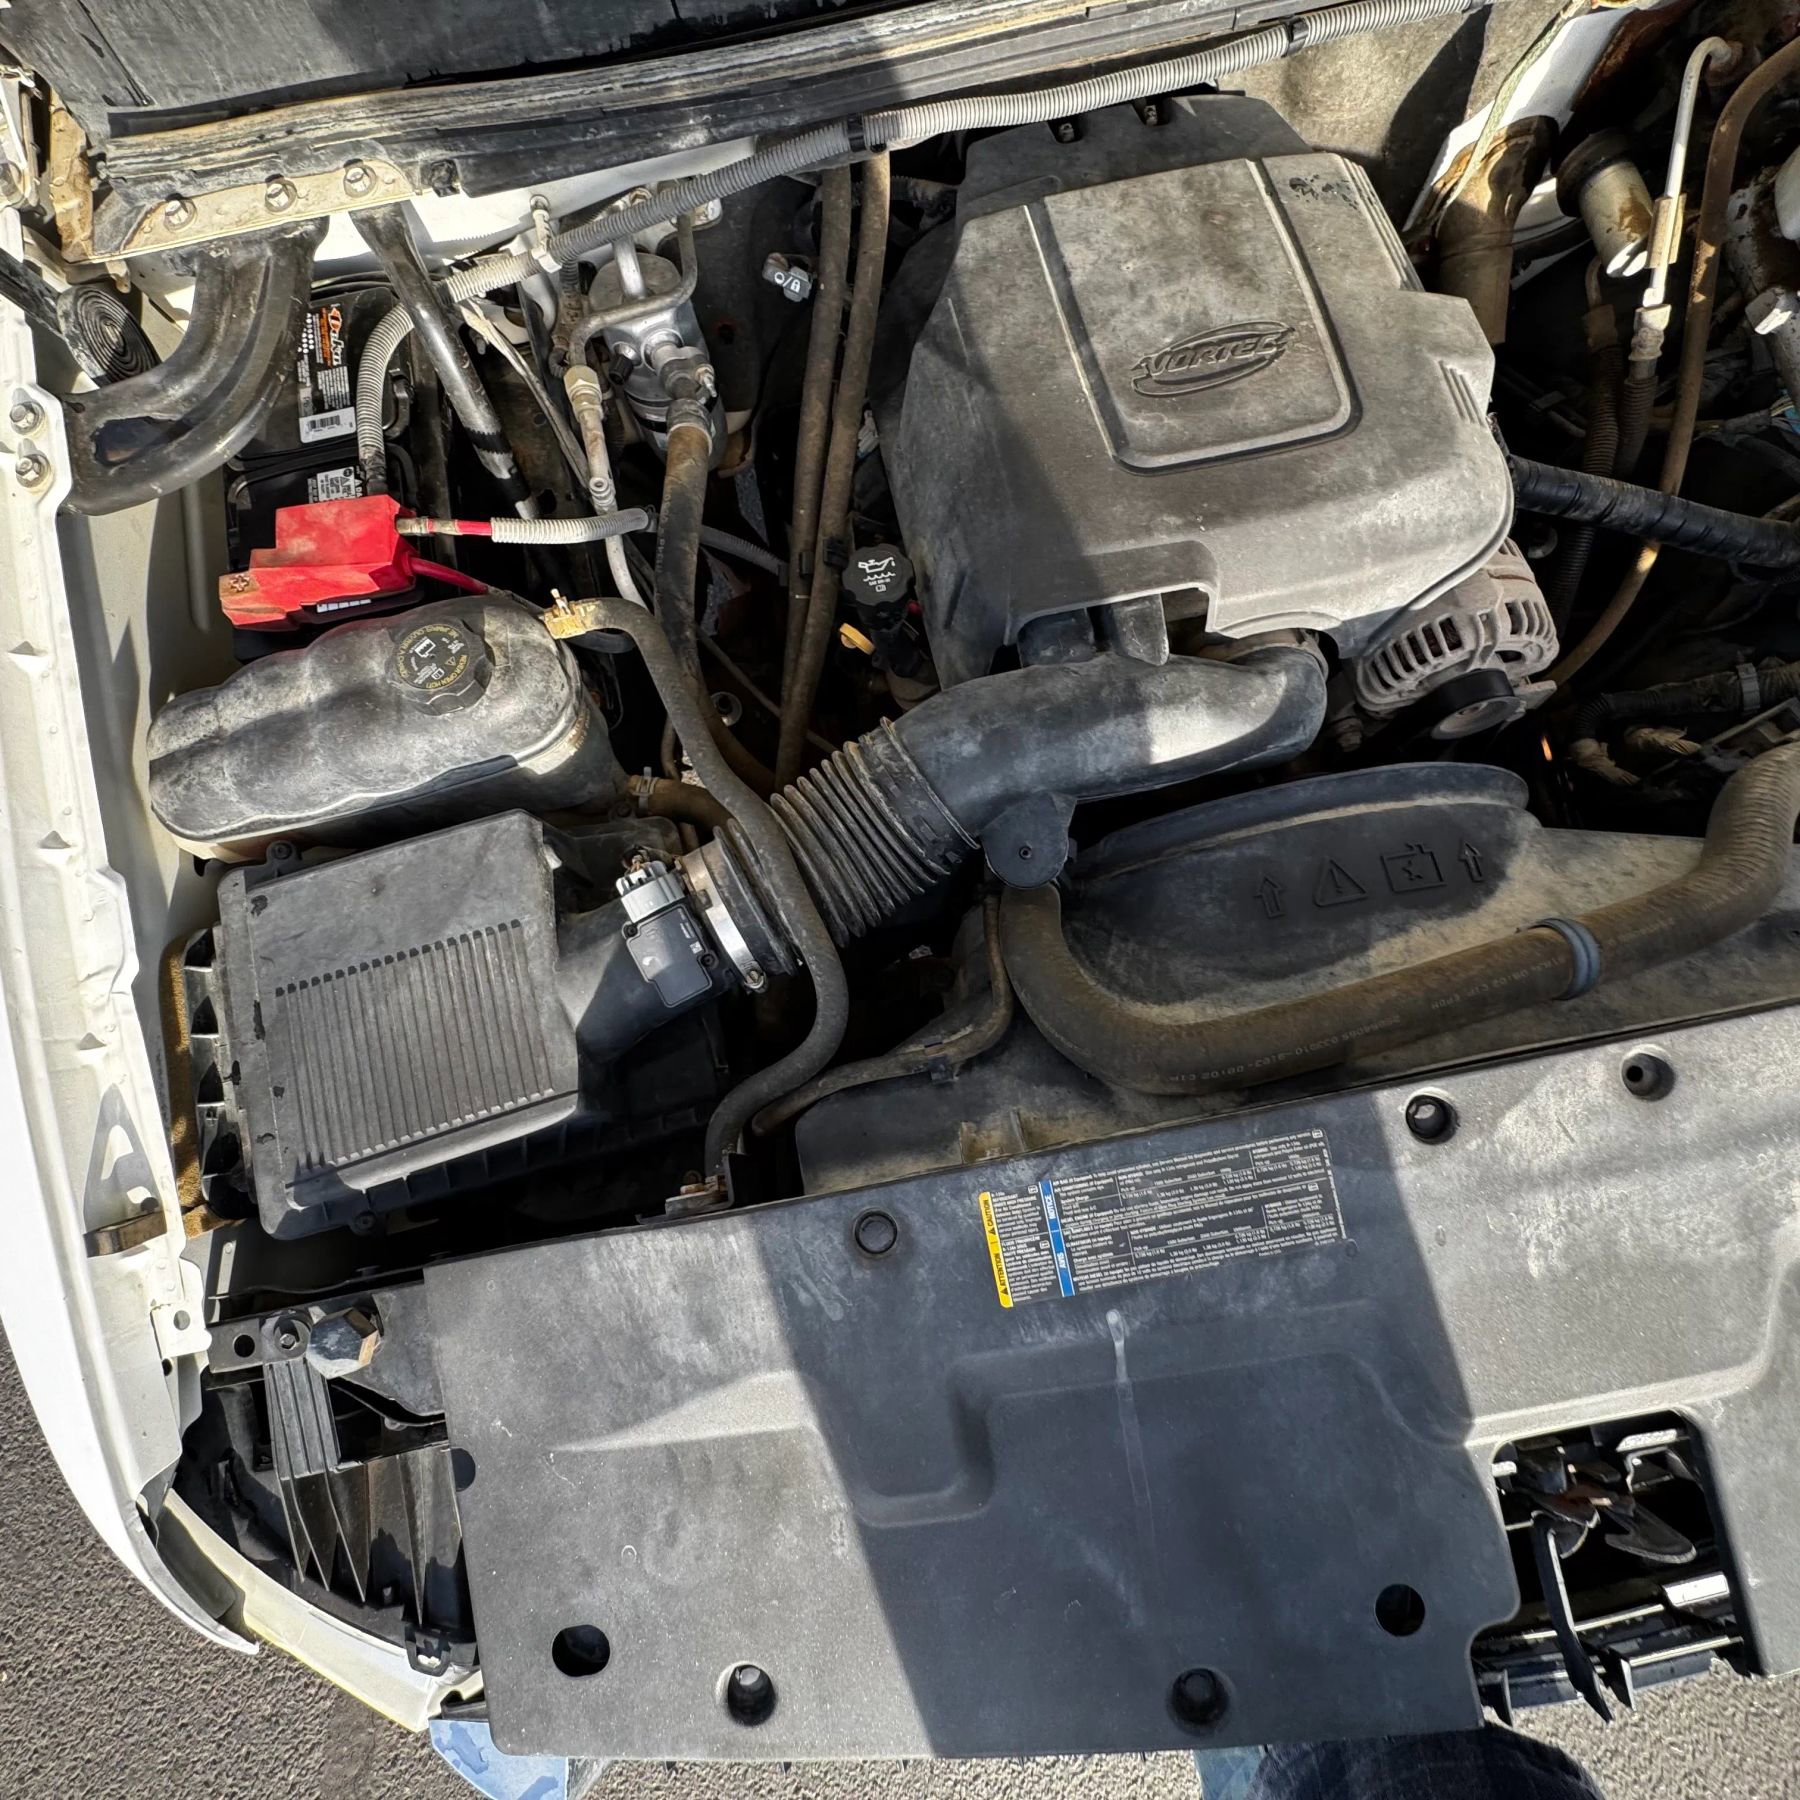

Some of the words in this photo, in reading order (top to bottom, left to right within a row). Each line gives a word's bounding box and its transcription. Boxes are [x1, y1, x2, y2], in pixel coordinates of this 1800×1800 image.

[1136, 333, 1287, 378] VORTEC
[984, 1199, 995, 1227] CAUTION
[1044, 1194, 1057, 1220] NOTICE
[995, 1252, 1009, 1287] ATTENTION
[1056, 1252, 1067, 1269] AVIS
